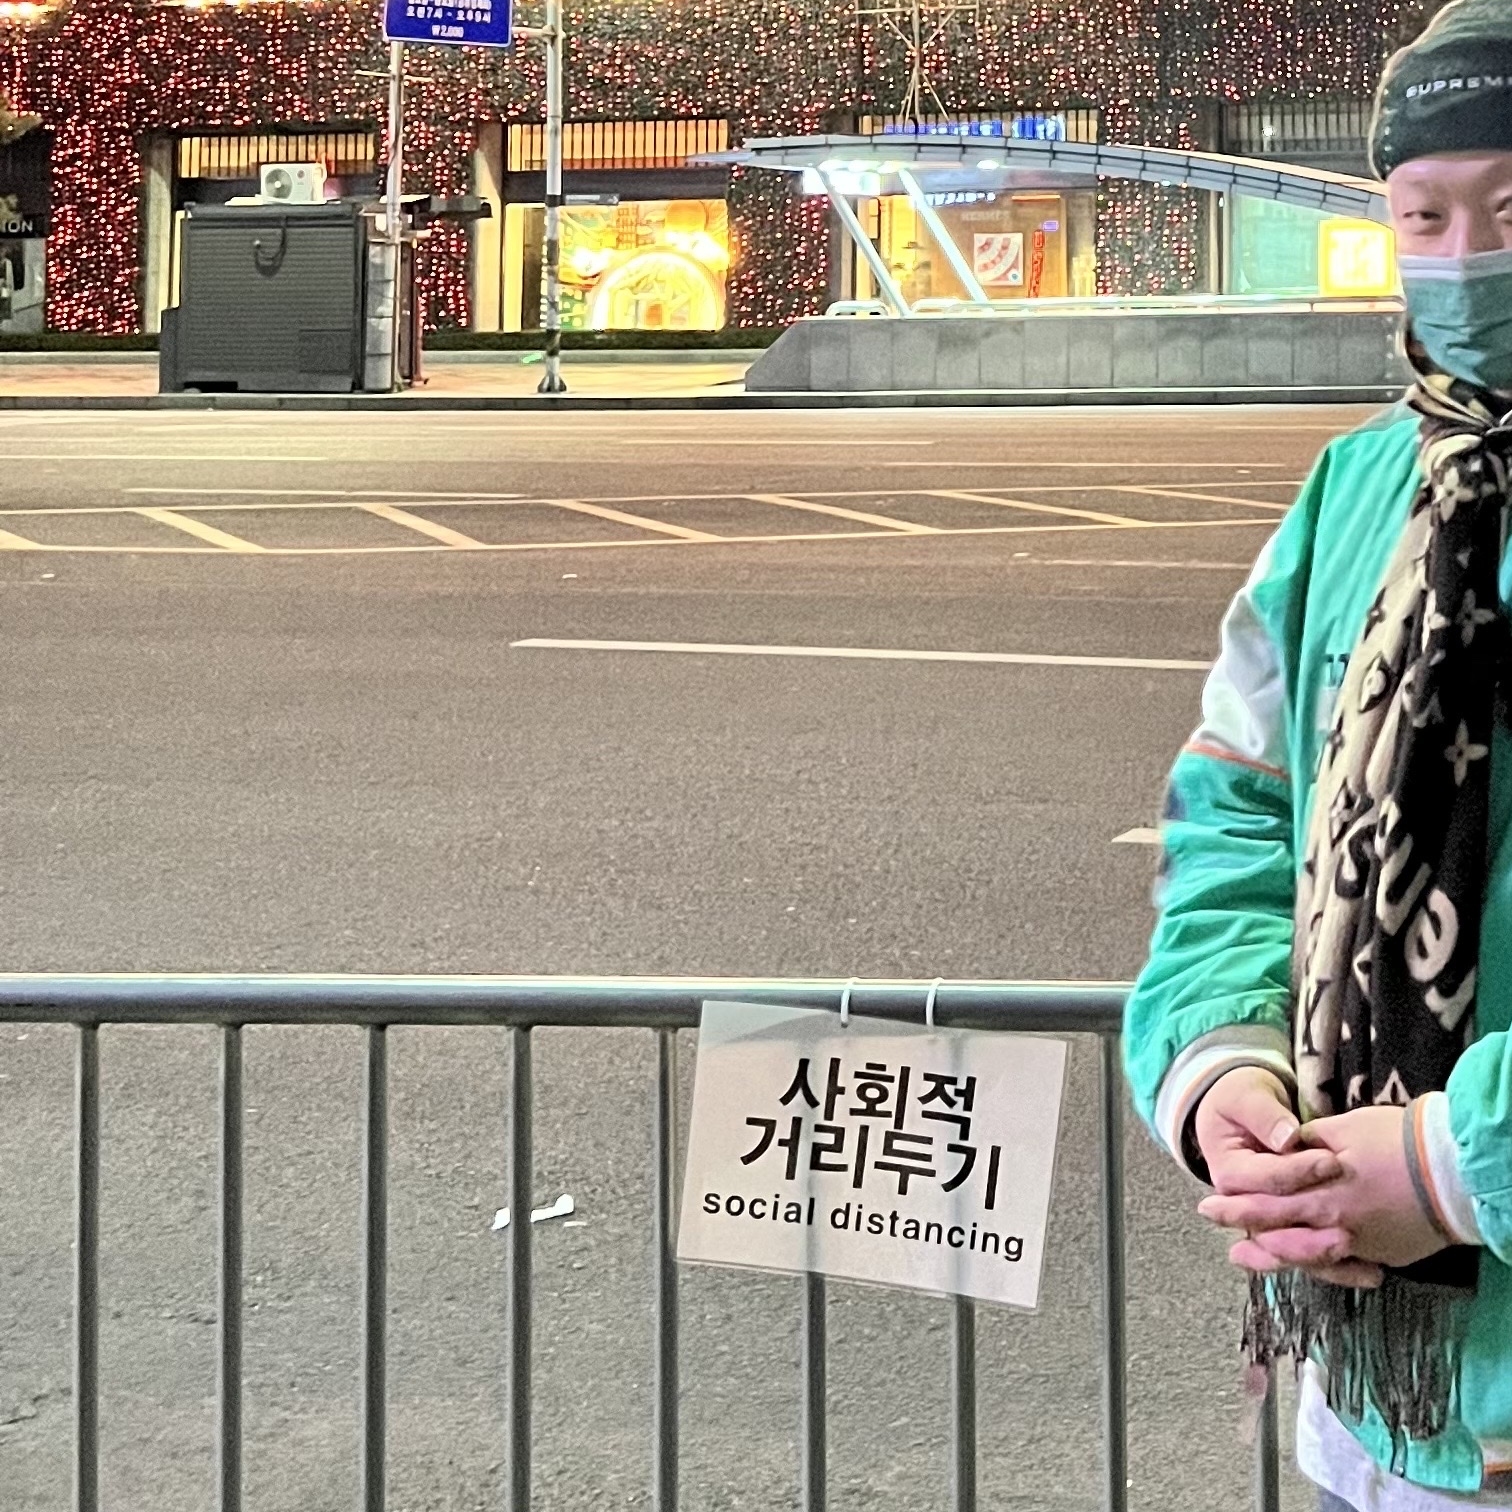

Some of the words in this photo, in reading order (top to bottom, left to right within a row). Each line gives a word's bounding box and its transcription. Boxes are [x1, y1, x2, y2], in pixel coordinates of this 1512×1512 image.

[779, 1057, 977, 1141] 사회적
[740, 1116, 1002, 1210] 거리두기
[702, 1190, 816, 1226] social
[830, 1202, 1025, 1263] distancing
